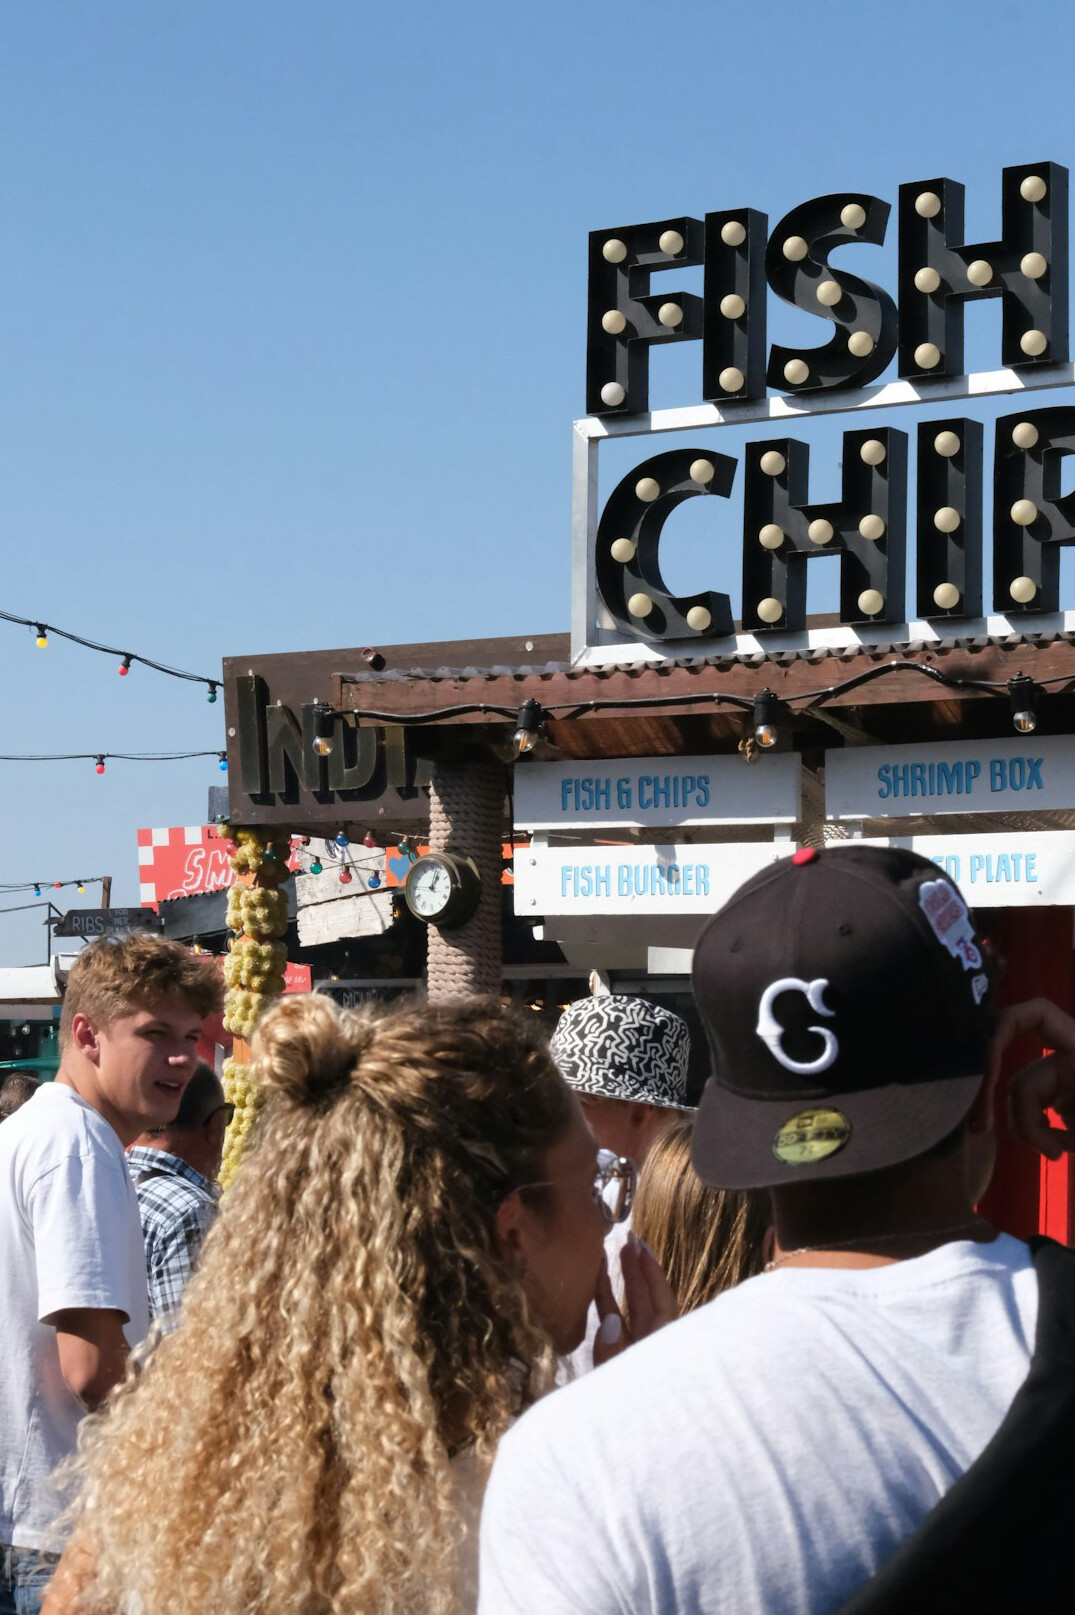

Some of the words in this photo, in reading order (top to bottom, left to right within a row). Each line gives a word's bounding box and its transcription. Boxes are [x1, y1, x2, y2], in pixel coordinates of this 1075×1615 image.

[586, 161, 1069, 415] FISH
[561, 778, 611, 811] FISH
[616, 777, 632, 809] &
[638, 775, 710, 809] CHIPS
[878, 760, 981, 798] SHRIMP
[989, 757, 1044, 793] BOX
[561, 865, 611, 897] FISH
[617, 863, 711, 897] BURGER
[970, 853, 1038, 883] PLATE
[72, 916, 104, 933] RIBS
